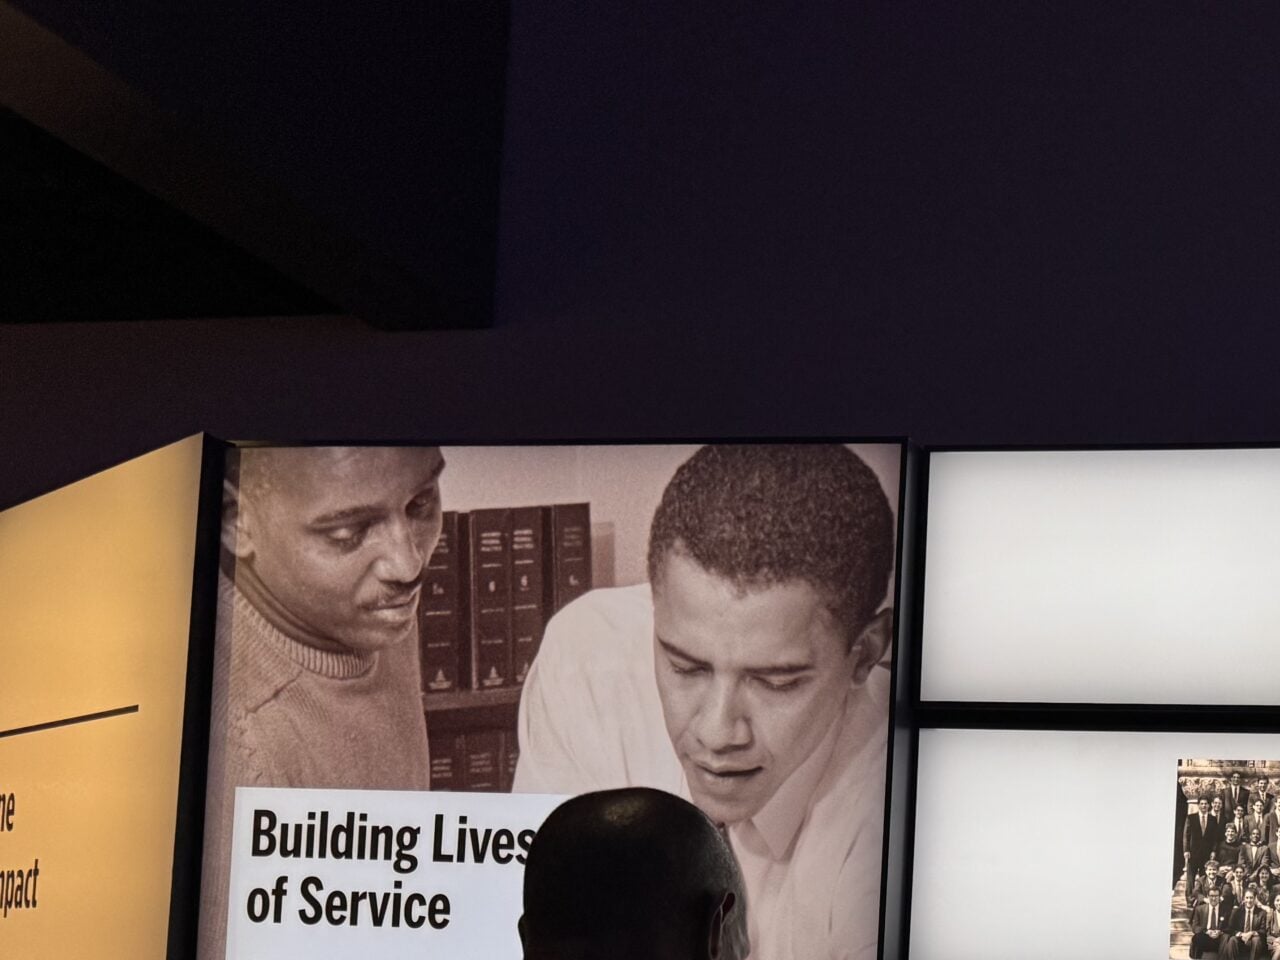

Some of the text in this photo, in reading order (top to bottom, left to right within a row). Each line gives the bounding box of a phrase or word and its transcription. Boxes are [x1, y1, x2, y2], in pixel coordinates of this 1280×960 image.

[251, 809, 421, 874] Building
[246, 875, 450, 929] of Service
